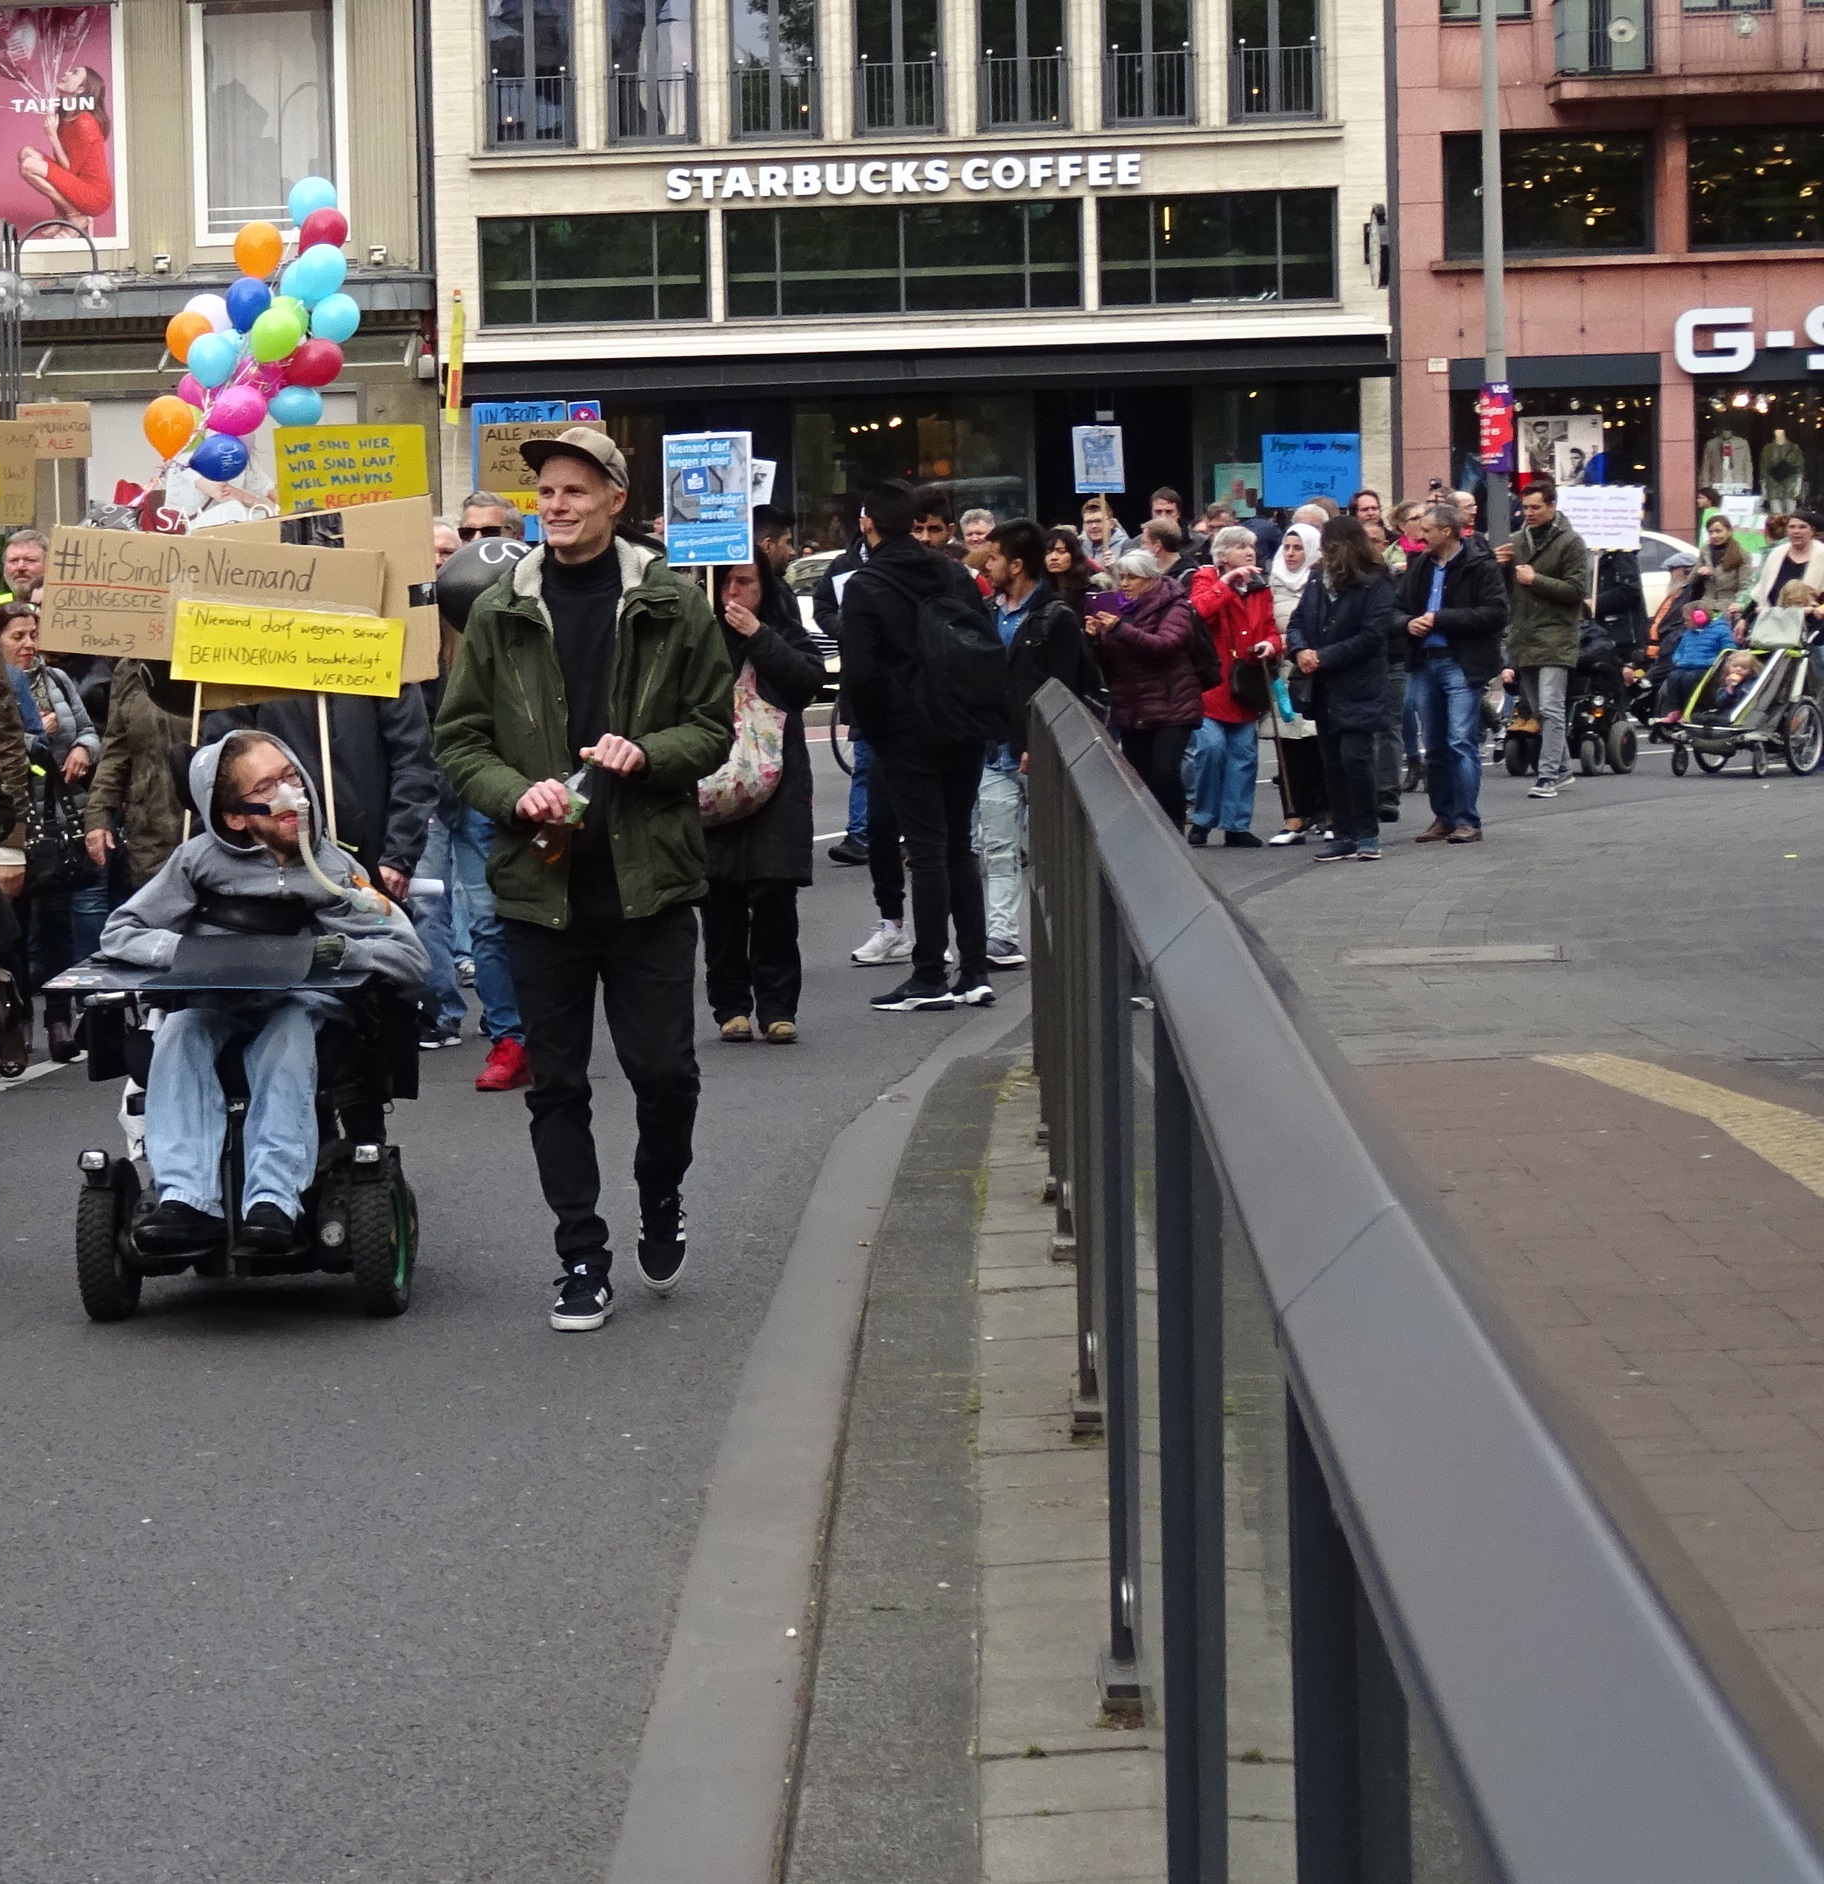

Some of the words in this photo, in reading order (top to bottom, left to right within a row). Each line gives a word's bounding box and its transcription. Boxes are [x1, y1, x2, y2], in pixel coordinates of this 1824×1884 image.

[11, 96, 95, 113] TAIFUN
[665, 158, 950, 200] STARBUCKS
[961, 153, 1142, 192] COFFEE
[485, 427, 522, 442] ALLE
[47, 439, 73, 450] ALLE
[318, 440, 351, 451] SIND
[668, 442, 709, 454] Niemand
[711, 440, 731, 452] darf
[288, 459, 316, 473] WIR
[323, 457, 356, 471] SIND
[668, 458, 699, 468] wegen
[701, 455, 730, 466] seiner
[291, 479, 326, 491] WEIL
[330, 472, 360, 486] MAN
[364, 472, 393, 485] UNS
[700, 493, 744, 505] behindert
[301, 622, 345, 640] wegen
[189, 643, 297, 666] BEHINDERUNG
